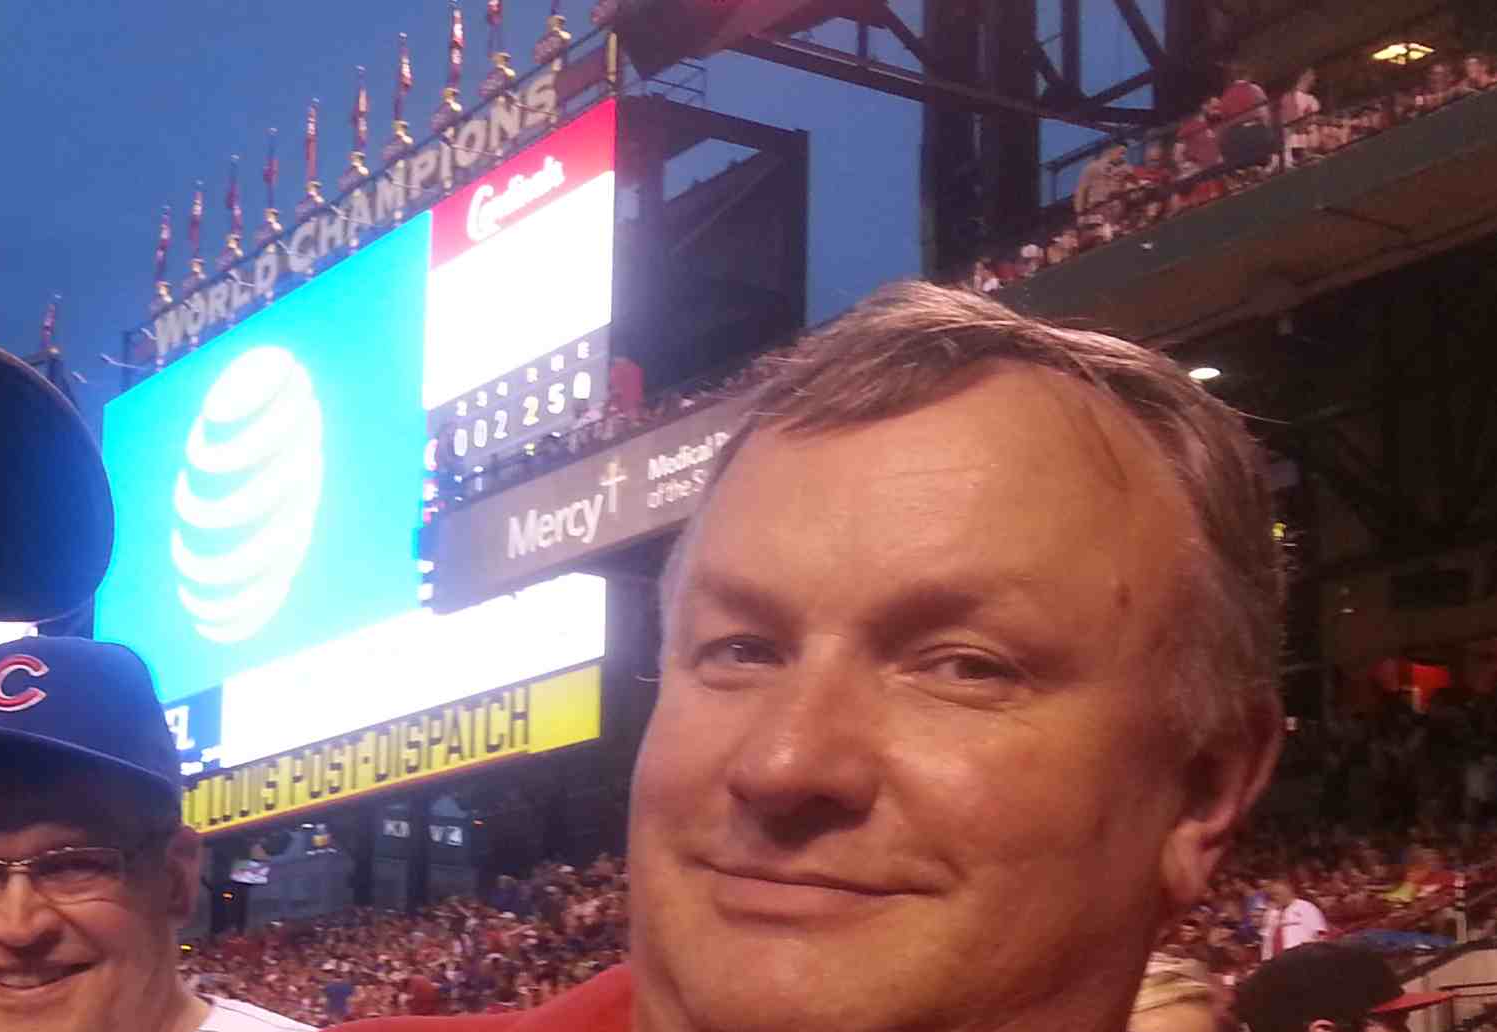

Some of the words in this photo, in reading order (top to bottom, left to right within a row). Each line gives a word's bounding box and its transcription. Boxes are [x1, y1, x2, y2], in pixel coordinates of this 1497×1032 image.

[154, 250, 279, 358] WORLD
[288, 72, 559, 273] CHAMPIONS
[506, 493, 604, 559] Mercy
